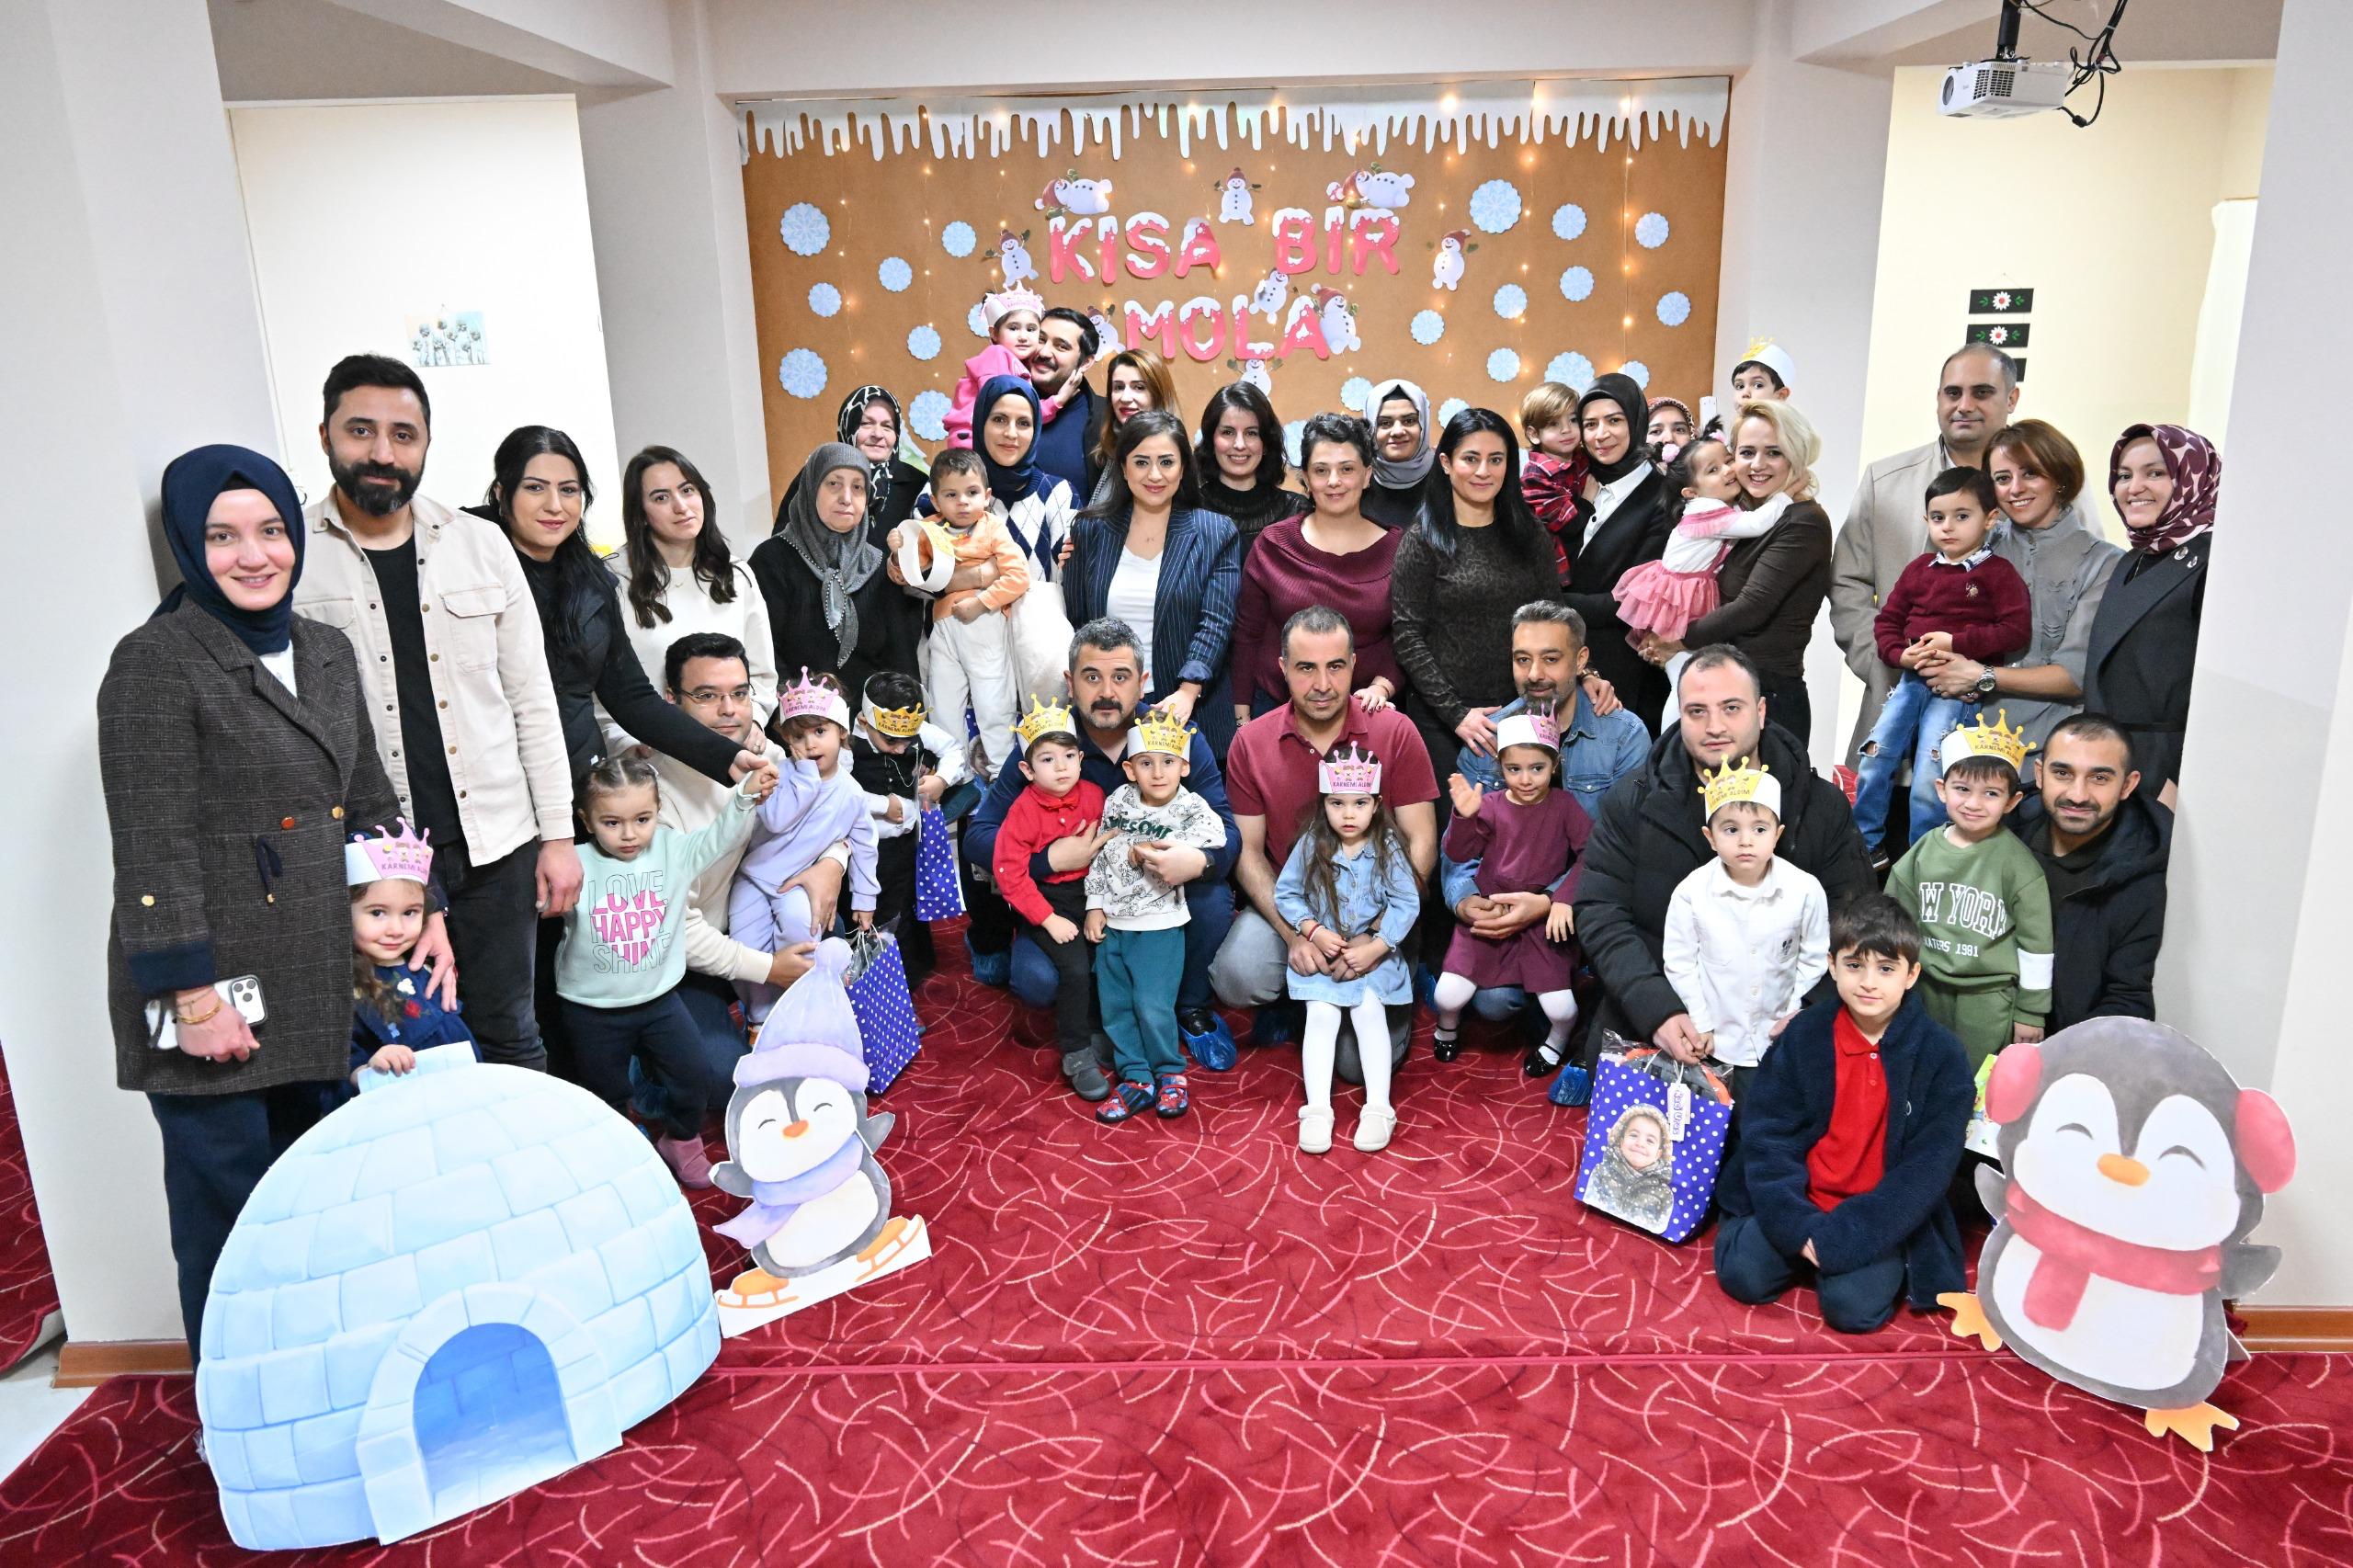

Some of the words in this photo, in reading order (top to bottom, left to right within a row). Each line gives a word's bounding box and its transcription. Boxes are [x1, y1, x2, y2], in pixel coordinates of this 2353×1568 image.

[1049, 212, 1222, 284] KISA
[1123, 294, 1329, 361] MOLA
[590, 905, 667, 945] HAPPY
[593, 932, 672, 975] SHINE
[1955, 943, 1979, 958] 1981
